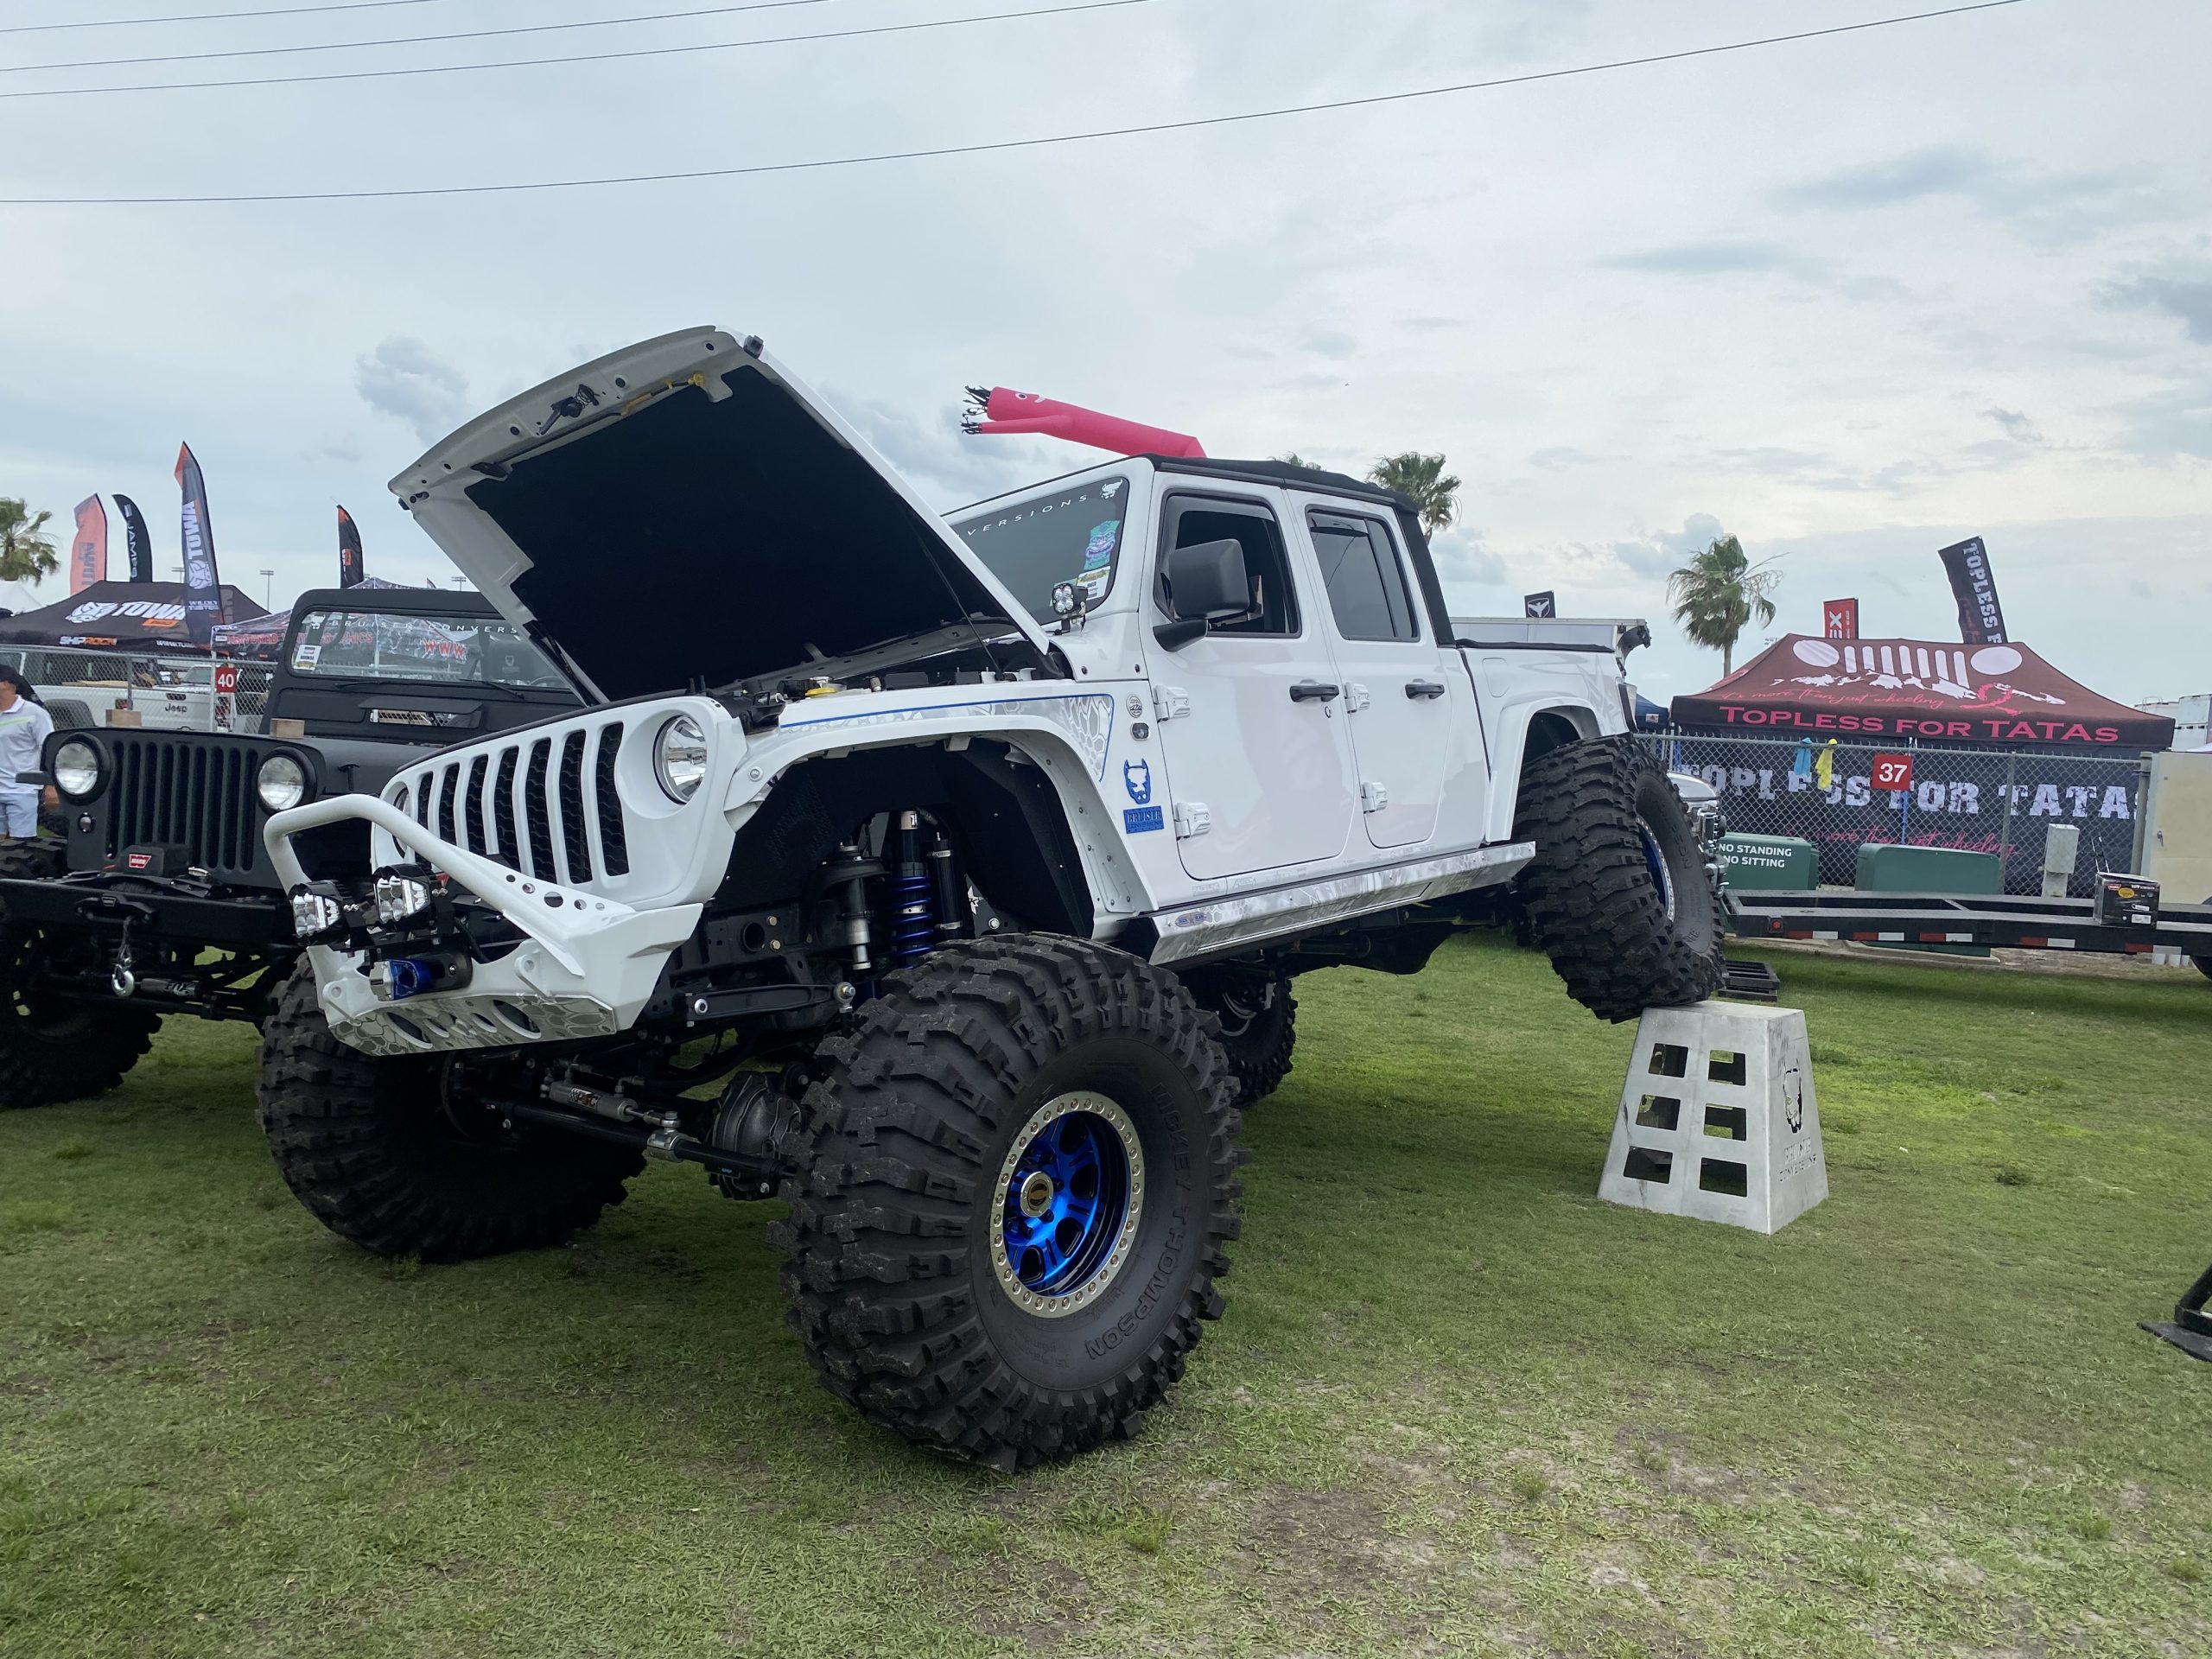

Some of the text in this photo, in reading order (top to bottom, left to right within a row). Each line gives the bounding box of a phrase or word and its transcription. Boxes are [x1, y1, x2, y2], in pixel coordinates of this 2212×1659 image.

[957, 493, 1087, 537] VERSIONS
[1962, 542, 1999, 628] TOPLESS
[428, 621, 518, 634] CONVERS
[217, 673, 235, 688] 40
[164, 702, 188, 713] Jeep
[1873, 694, 1945, 709] wheeling
[1719, 706, 2119, 743] TOPLESS FOR TATAS
[1878, 762, 1908, 783] 37
[1998, 783, 2138, 820] TATA
[1127, 810, 1162, 823] BRUISER
[1719, 843, 1792, 857] NO STANDING
[1723, 855, 1785, 868] NO SITTING
